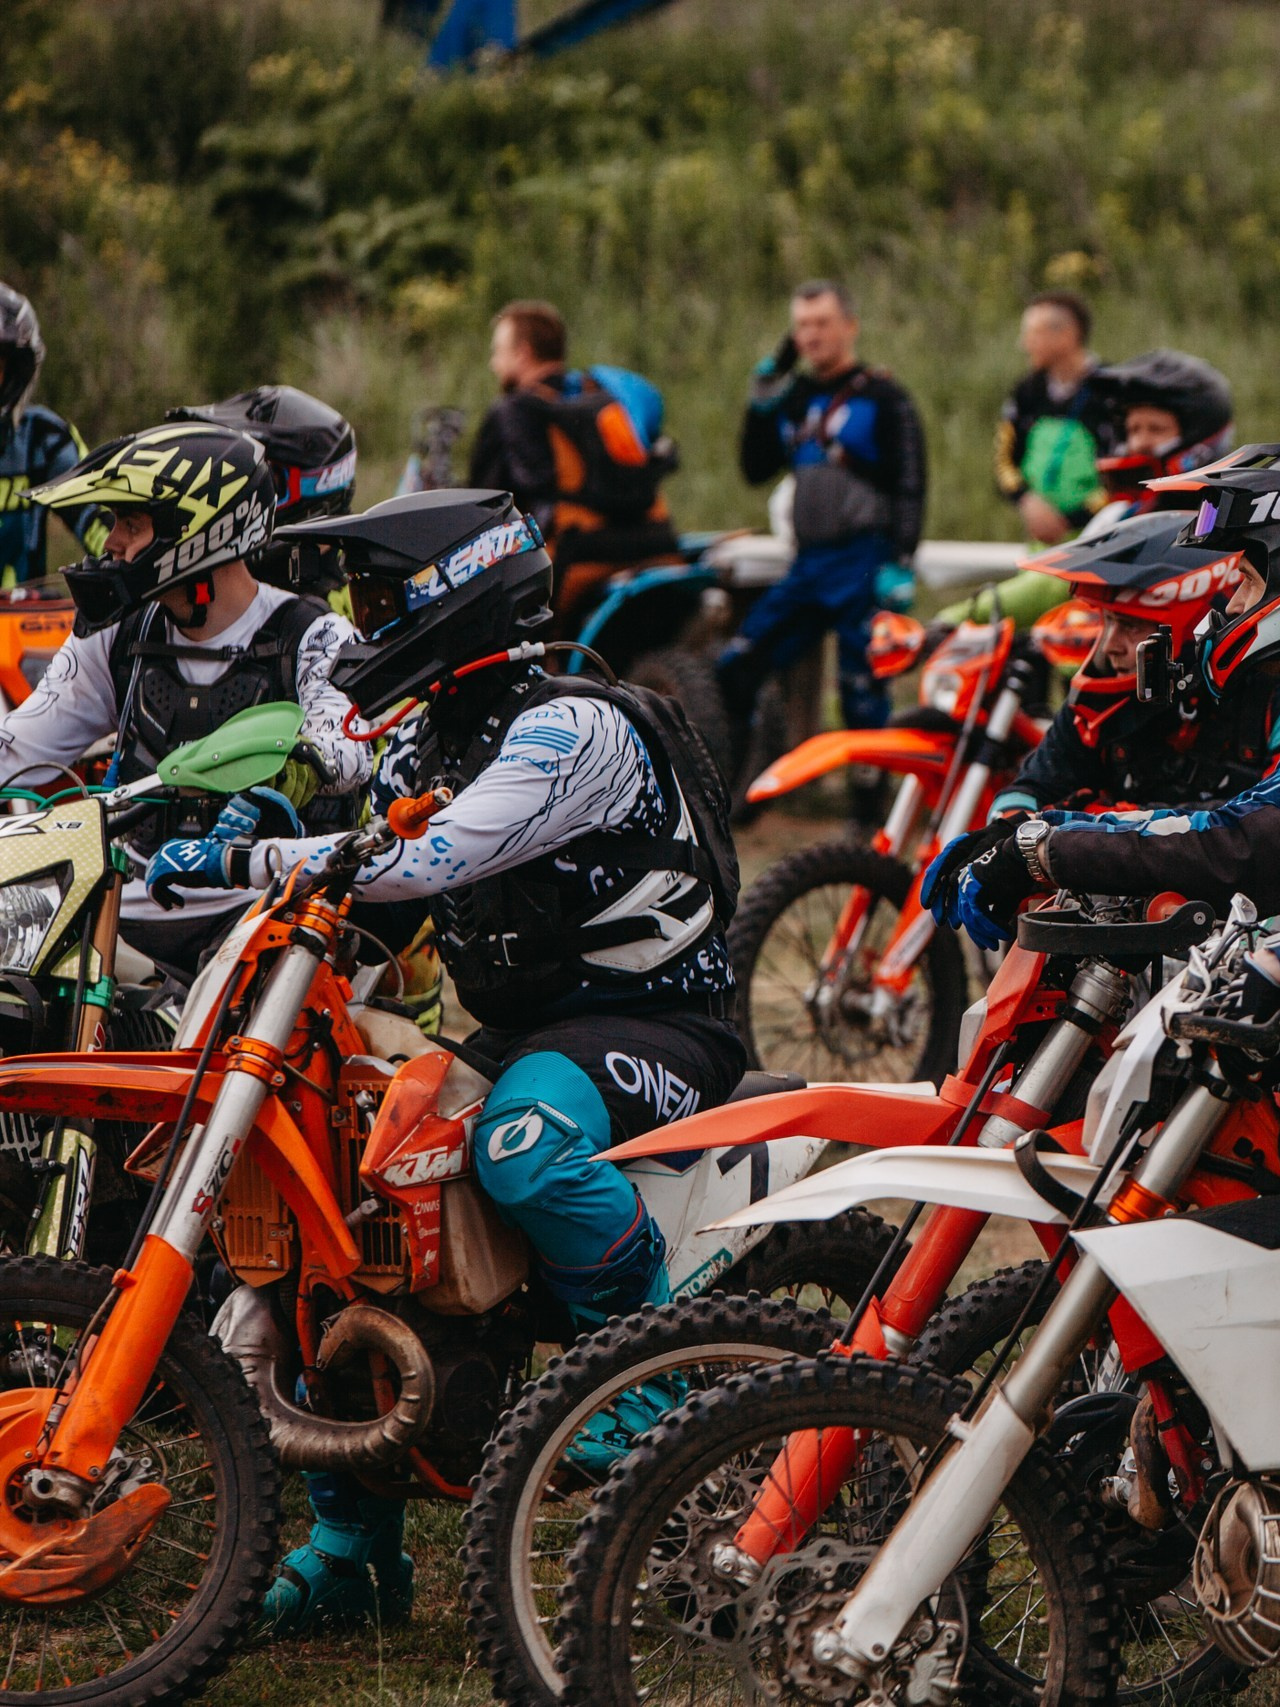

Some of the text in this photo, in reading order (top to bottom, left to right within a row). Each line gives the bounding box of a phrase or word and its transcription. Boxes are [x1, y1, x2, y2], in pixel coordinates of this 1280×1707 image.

[154, 490, 262, 584] 100%
[428, 519, 523, 597] LEATT
[522, 710, 567, 721] FOX
[383, 1145, 464, 1187] KTM
